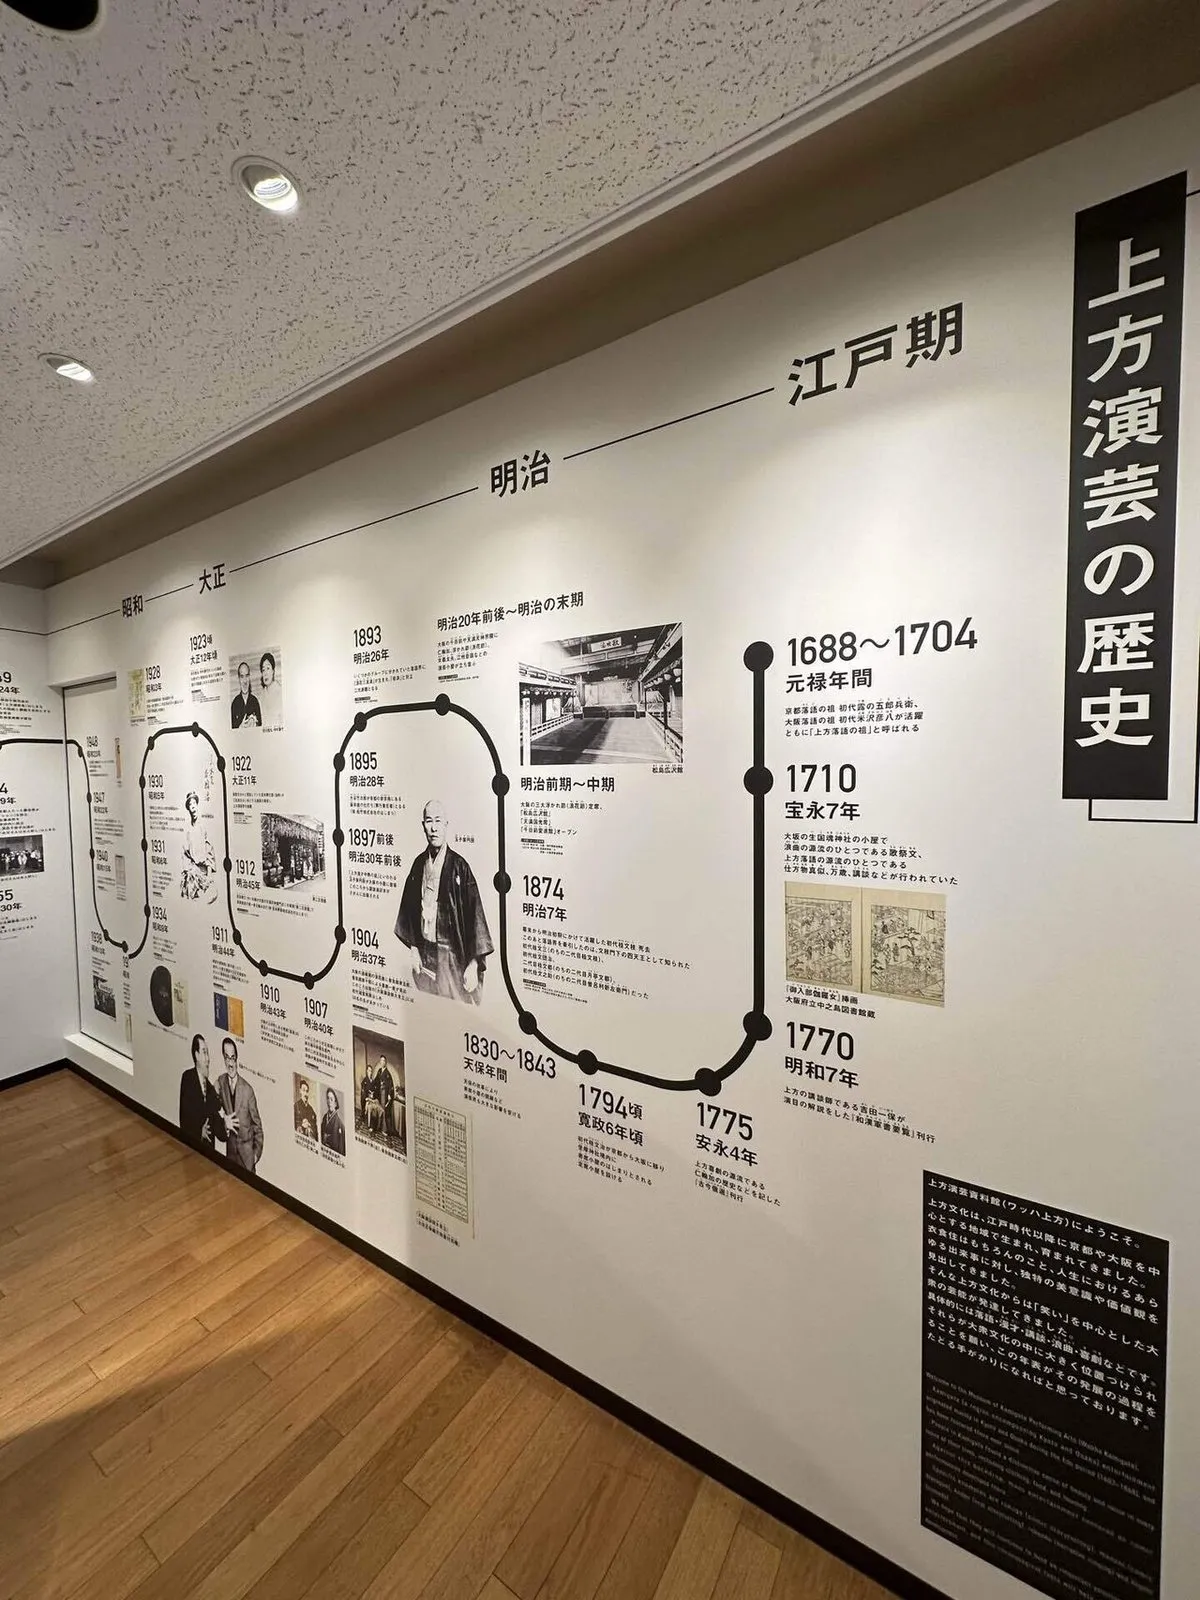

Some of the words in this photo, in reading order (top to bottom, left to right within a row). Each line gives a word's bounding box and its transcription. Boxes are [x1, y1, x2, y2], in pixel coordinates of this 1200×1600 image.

[788, 302, 962, 406] 江戸期
[491, 450, 551, 497] 明治
[1075, 237, 1165, 747] 上方演芸の歴史
[199, 563, 226, 594] 大正
[122, 595, 143, 618] 昭和
[437, 591, 584, 631] 明治20年前後～明治の末期
[190, 634, 213, 651] 1923頃
[353, 625, 382, 648] 1893
[787, 617, 977, 667] 1688～1704
[190, 650, 218, 665] 大正12年頃
[353, 649, 390, 664] 明治26年
[146, 665, 161, 680] 1928
[786, 668, 872, 693] 元禄年間
[785, 704, 835, 715] 京都落語の祖
[785, 716, 835, 727] 大阪落語の祖
[839, 711, 924, 724] 初代米沢彦八が活躍
[785, 725, 920, 737] ともに「上方落語の祖」と呼ばれる
[232, 756, 251, 771] 1922
[350, 752, 377, 770] 1895
[148, 775, 164, 788] 1930
[232, 776, 257, 786] 大正11年
[350, 776, 385, 787] 明治28年
[521, 777, 615, 792] 明治前期～中期
[787, 764, 857, 793] 1710
[785, 801, 860, 821] 宝永7年
[151, 839, 165, 853] 1931
[349, 829, 394, 847] 1897前後
[784, 832, 888, 845] 大坂の生国魂神社の小屋で
[349, 852, 402, 867] 明治30年前後
[784, 843, 923, 859] 浪曲の源流のひとつである歌祭文、
[236, 860, 255, 876] 1912
[784, 855, 907, 869] 上方落語の源流のひとつである
[236, 879, 261, 890] 明治45年
[784, 865, 958, 885] 仕方物真似、万歳、講談などが行われていた
[523, 875, 564, 900] 1874
[152, 906, 168, 921] 1934
[522, 903, 567, 921] 明治7年
[212, 926, 228, 943] 1911
[351, 928, 379, 949] 1904
[351, 950, 386, 967] 明治37年
[260, 984, 280, 1003] 1910
[261, 1003, 286, 1019] 明治43年
[304, 998, 328, 1018] 1907
[785, 996, 876, 1019] 大阪府立中之島図書館蔵
[304, 1018, 334, 1036] 明治40年
[787, 1021, 854, 1061] 1770
[464, 1033, 556, 1079] 1830～1843
[464, 1056, 507, 1083] 天保年間
[785, 1056, 859, 1088] 明和7年
[579, 1083, 643, 1120] 1794頃
[784, 1086, 906, 1123] 上方の講談師である吉田一保が
[578, 1112, 643, 1147] 寛政6年頃
[697, 1102, 753, 1140] 1775
[695, 1133, 758, 1167] 安永4年
[928, 1198, 1160, 1277] 上方文化は、江戸時代以降に京都や大阪を中
[928, 1211, 1146, 1289] 心とする地域で生まれ、育まれてきました。
[928, 1224, 1158, 1309] 衣食住はもちろんのこと、人生におけるあら
[928, 1252, 1016, 1290] 見出してきました。
[928, 1238, 1158, 1325] ゆる出来事に対し、独特の美意識や価値観を
[928, 1278, 1074, 1340] 衆の芸能が発達してきました。
[928, 1265, 1160, 1357] そんな上方文化からは「笑い」を中心とした大
[928, 1318, 1156, 1418] ることを願い、この年表がその発展の過程を
[928, 1332, 1150, 1430] たどる手がかりになればと思っております。
